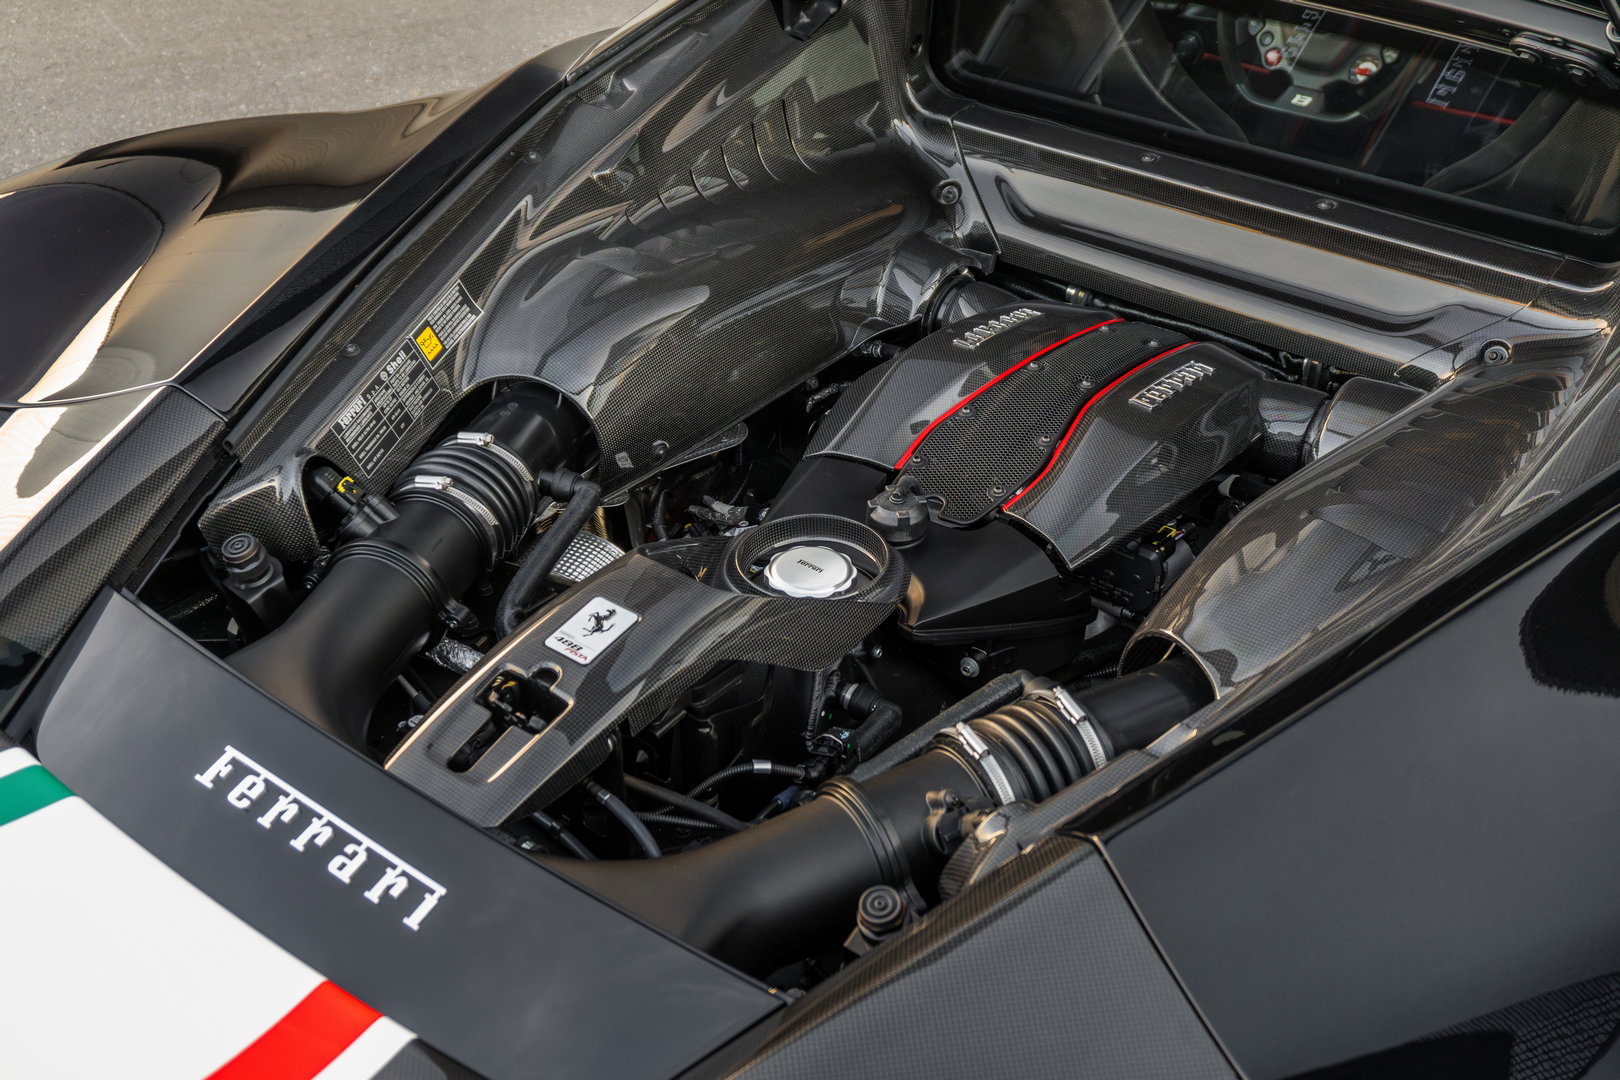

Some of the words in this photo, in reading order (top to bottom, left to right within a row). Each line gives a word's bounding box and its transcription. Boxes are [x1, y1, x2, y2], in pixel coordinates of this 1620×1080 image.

[337, 394, 367, 430] Ferrari
[386, 349, 407, 374] Shell
[1128, 360, 1216, 412] Ferrari
[797, 559, 824, 574] Ferrari
[554, 636, 583, 652] 488
[194, 744, 447, 931] Ferrari
